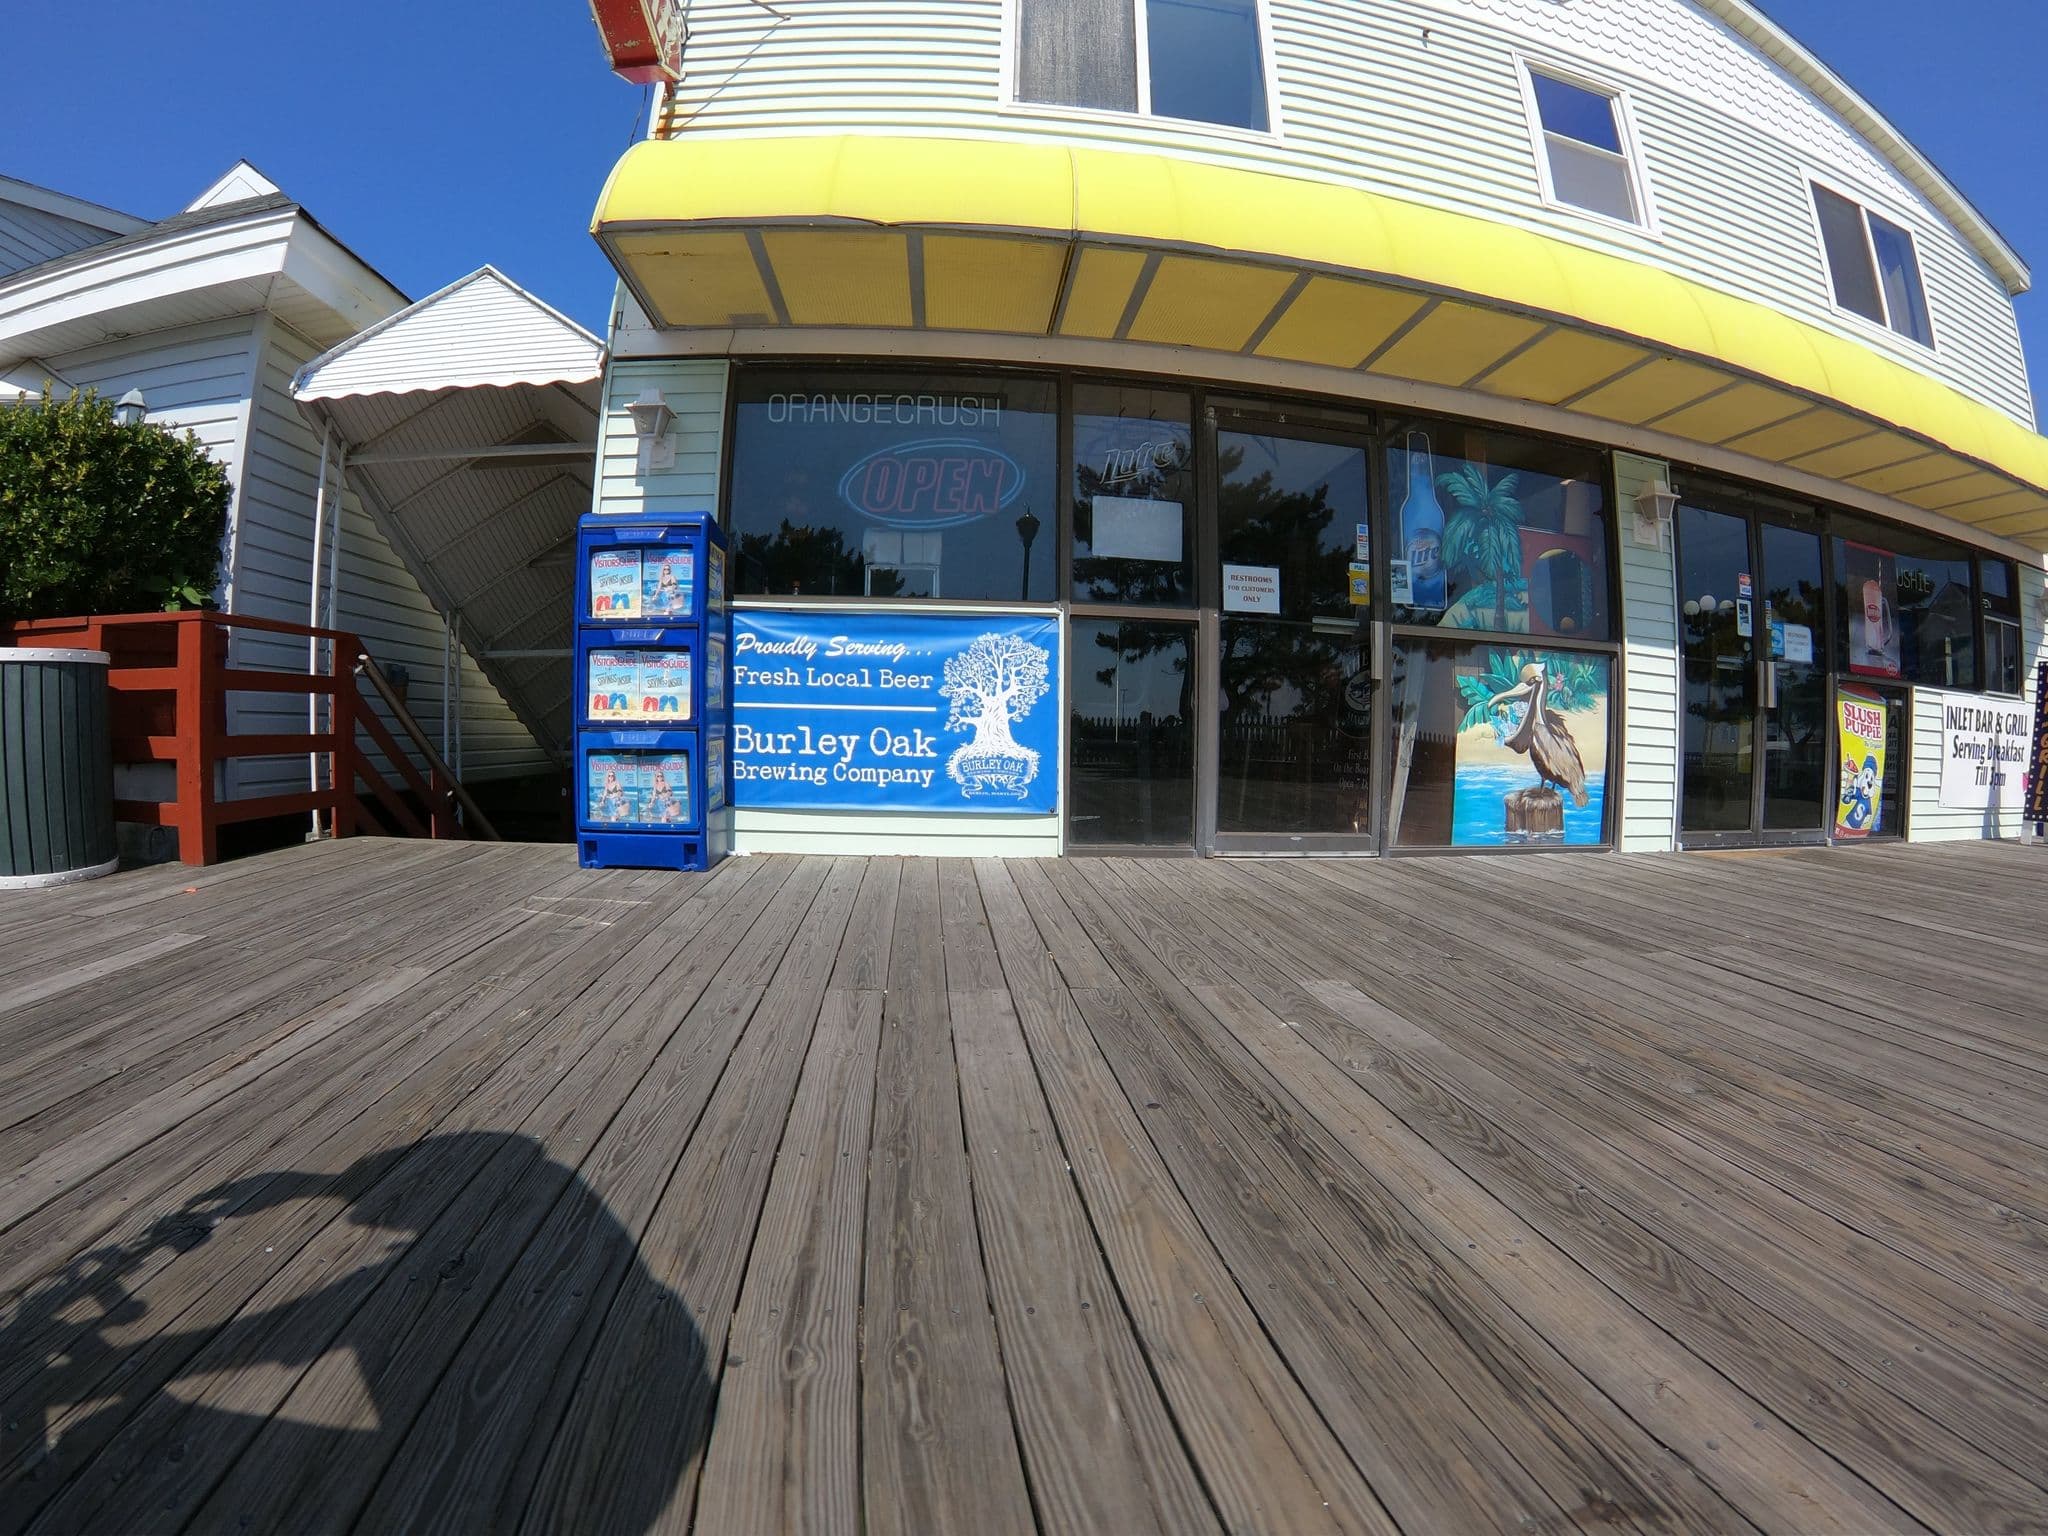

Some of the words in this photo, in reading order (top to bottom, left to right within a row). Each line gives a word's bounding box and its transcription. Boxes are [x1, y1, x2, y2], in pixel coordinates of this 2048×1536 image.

[862, 457, 1005, 514] OPEN
[1230, 574, 1273, 584] RESTROOMS
[1241, 585, 1275, 593] CUSTOMERS
[1896, 567, 1931, 593] USHIE
[1242, 595, 1261, 603] ONLY
[735, 632, 817, 661] Proudly
[824, 634, 932, 663] Serving...
[733, 665, 800, 687] Fresh
[806, 667, 872, 688] Local
[879, 669, 934, 690] Beer
[1843, 702, 1881, 726] SLUSH
[1946, 705, 1974, 731] INLET
[1975, 709, 1993, 734] BAR
[1995, 711, 2004, 734] &
[2005, 713, 2028, 737] GRILL
[733, 723, 861, 763] Burley
[869, 727, 938, 759] Oak
[1952, 735, 1986, 765] Serving
[1987, 737, 2025, 763] Breakfast
[733, 761, 827, 785] Brewing
[833, 762, 935, 788] Company
[962, 758, 1002, 773] BURLEY
[1003, 759, 1024, 773] OAK
[1974, 765, 1988, 786] Till
[1989, 767, 2006, 791] 3pm
[1853, 803, 1866, 821] S
